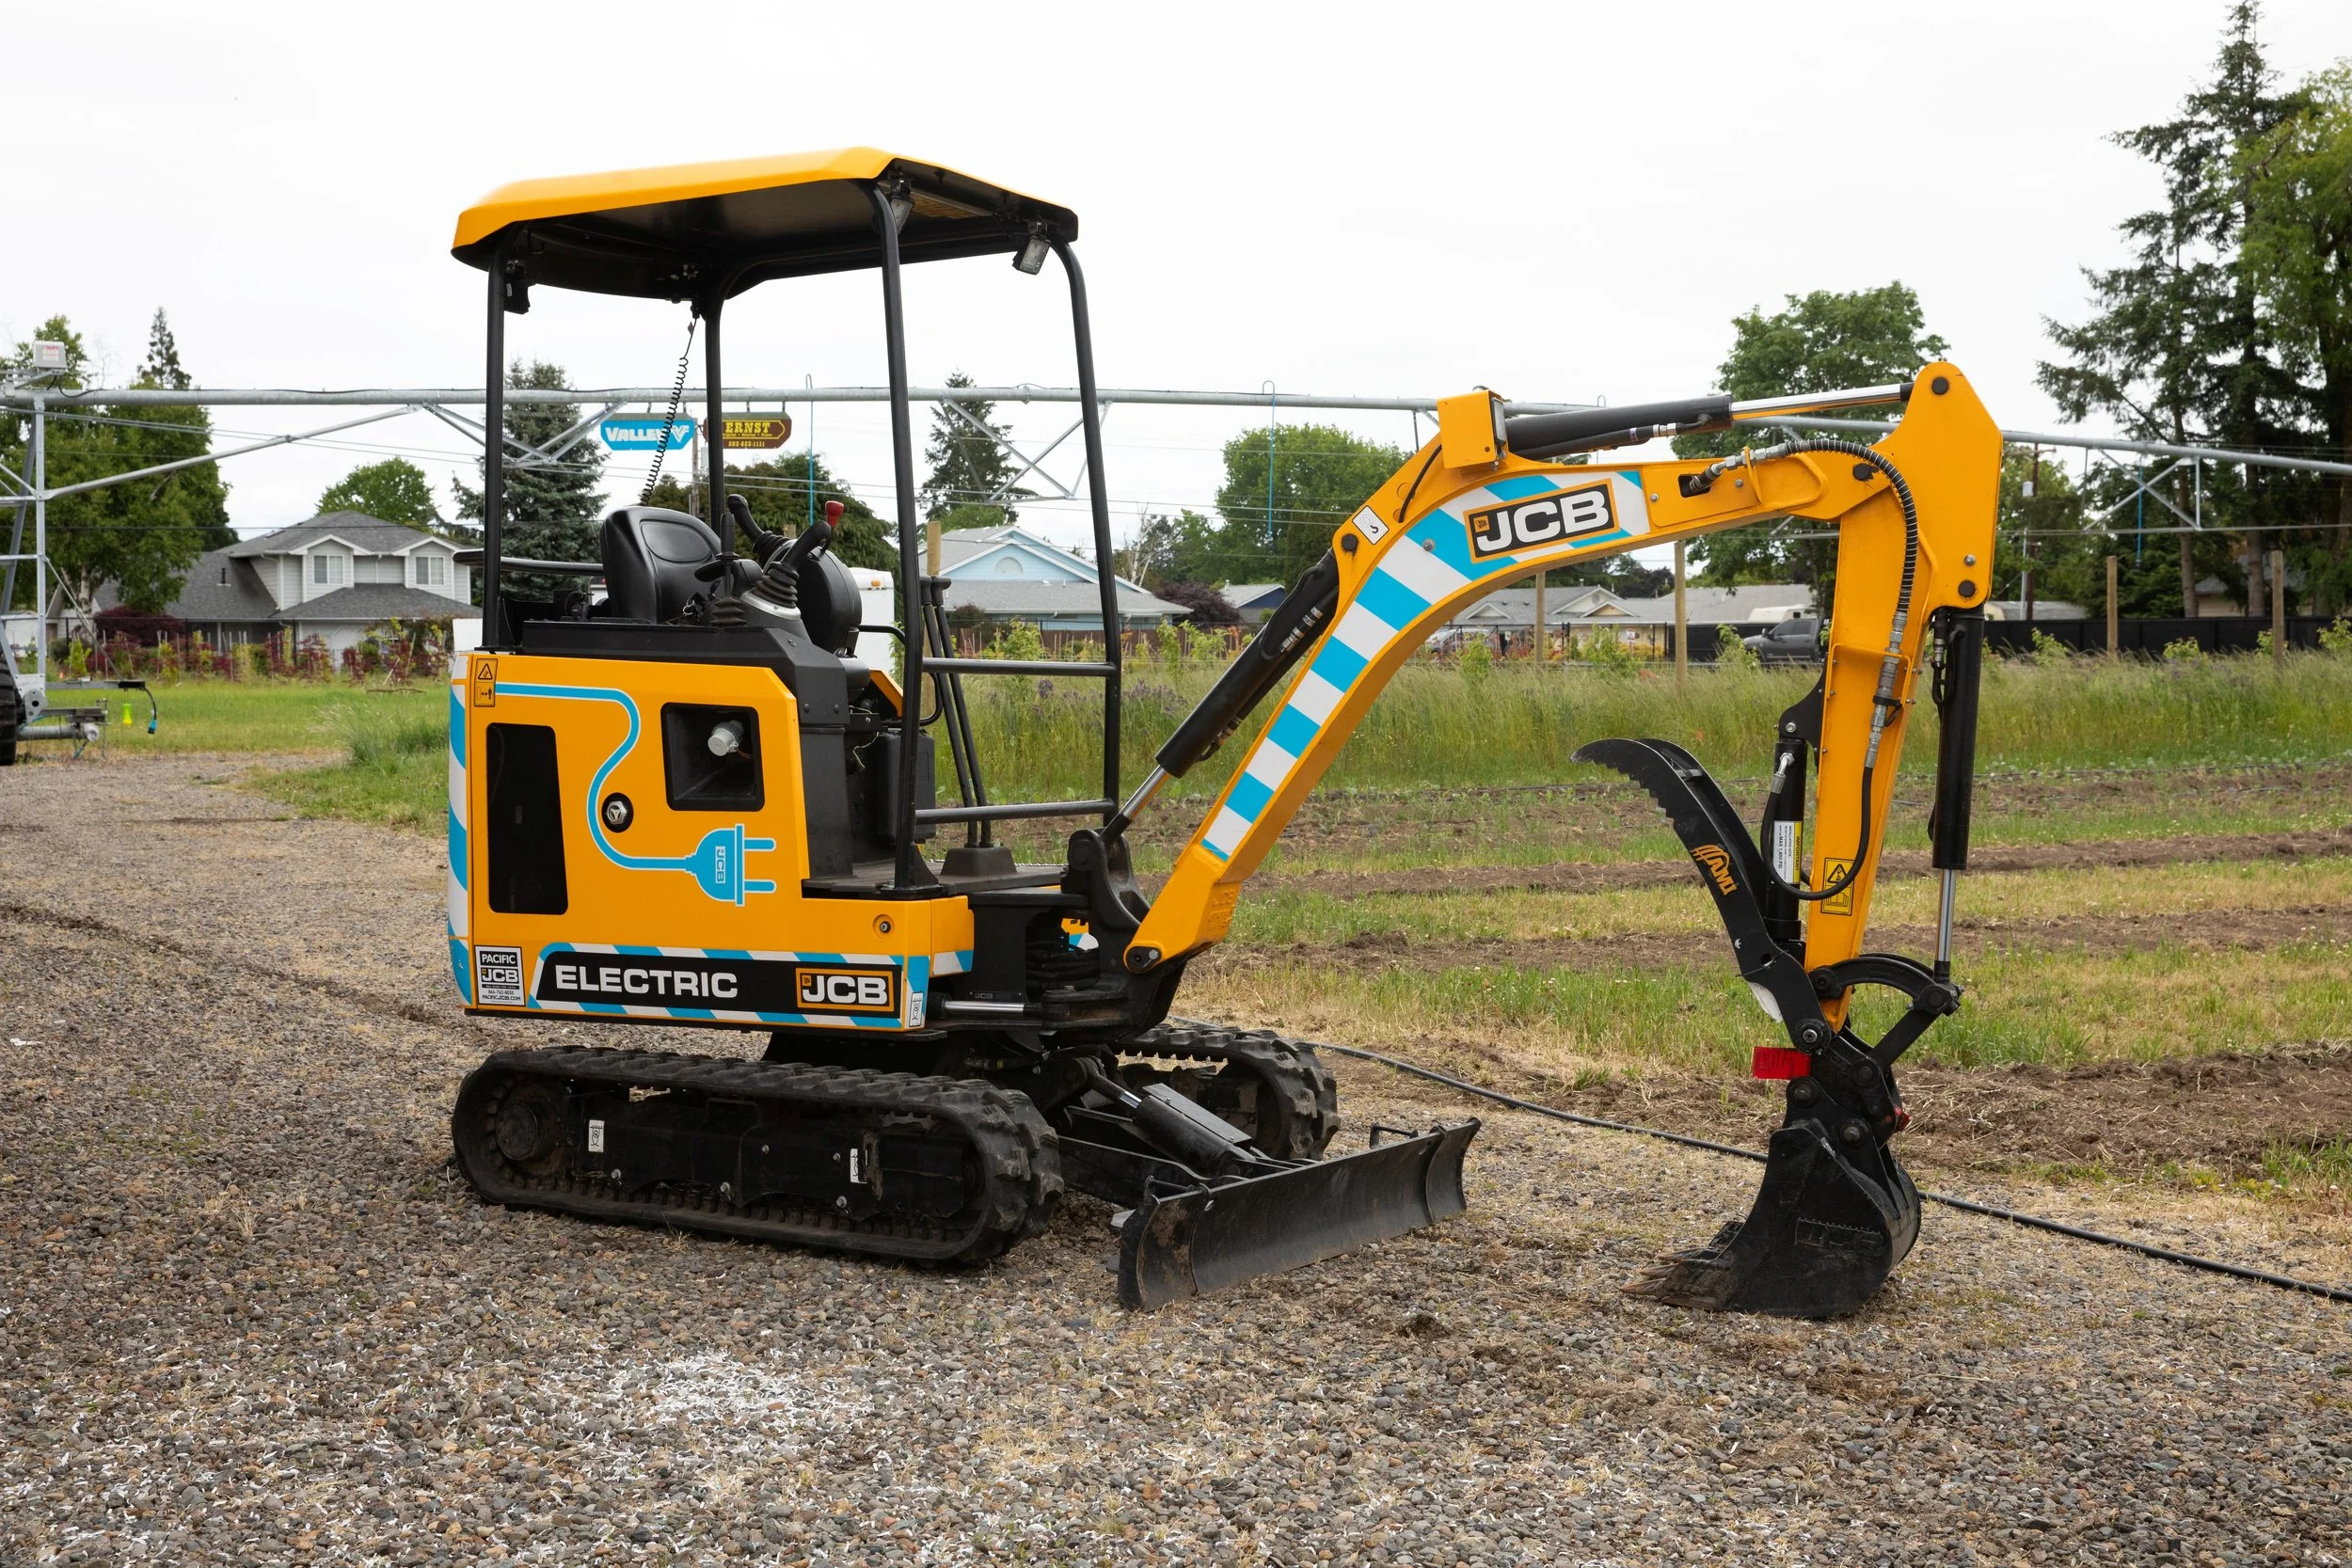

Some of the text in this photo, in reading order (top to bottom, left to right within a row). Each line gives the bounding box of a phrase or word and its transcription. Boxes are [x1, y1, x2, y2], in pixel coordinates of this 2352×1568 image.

[725, 421, 771, 434] ERNST
[1476, 490, 1610, 552] JCB
[716, 848, 724, 882] JCB
[481, 954, 516, 964] PACIFIC
[482, 969, 518, 983] JCB
[555, 964, 739, 999] ELECTRIC
[803, 975, 887, 1005] JCB
